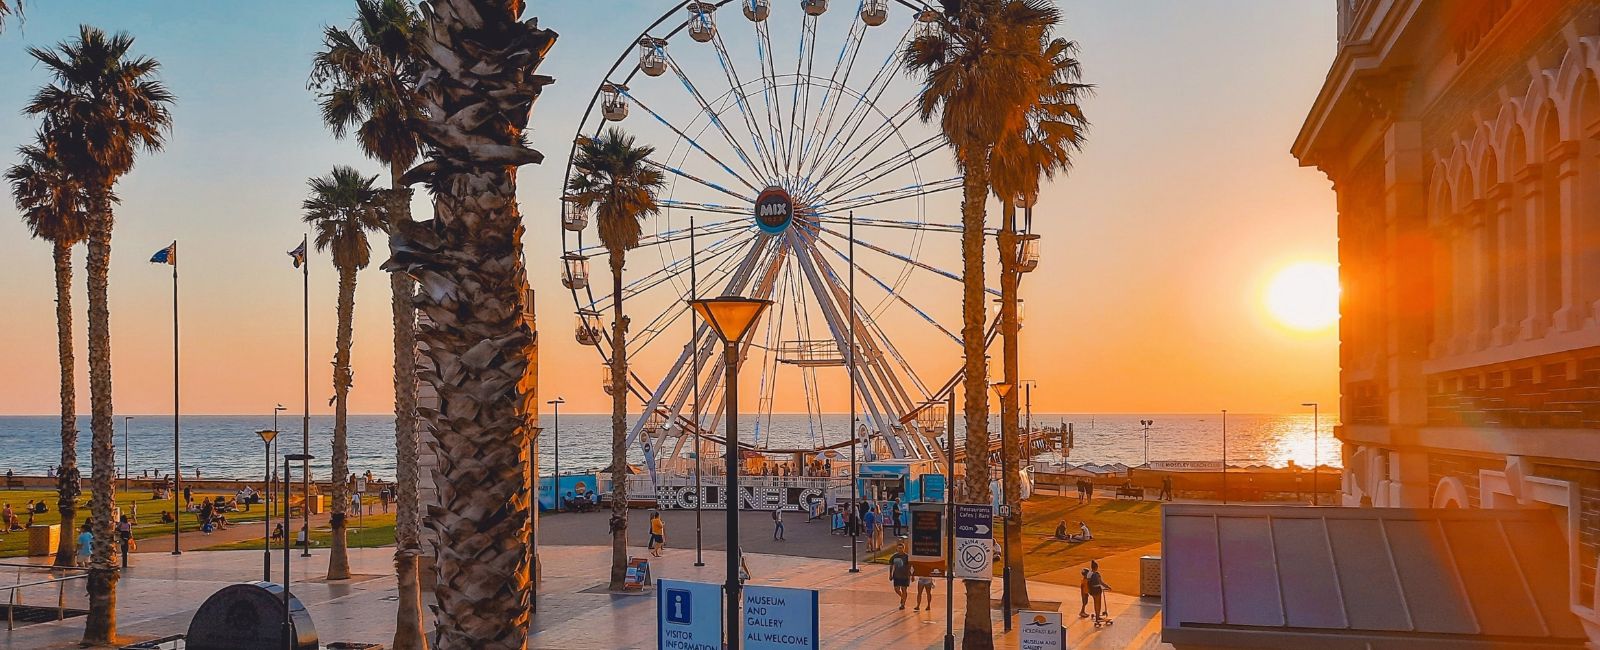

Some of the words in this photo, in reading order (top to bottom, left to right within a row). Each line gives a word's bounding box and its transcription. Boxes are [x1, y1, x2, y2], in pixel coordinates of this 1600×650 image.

[760, 203, 787, 216] MIX
[747, 596, 786, 606] MUSEUM
[747, 606, 767, 616] AND
[747, 617, 784, 628] GALLERY
[665, 629, 693, 641] VISITOR
[747, 633, 762, 642] ALL
[763, 633, 809, 646] WELCOME
[665, 639, 718, 650] INFORMATION
